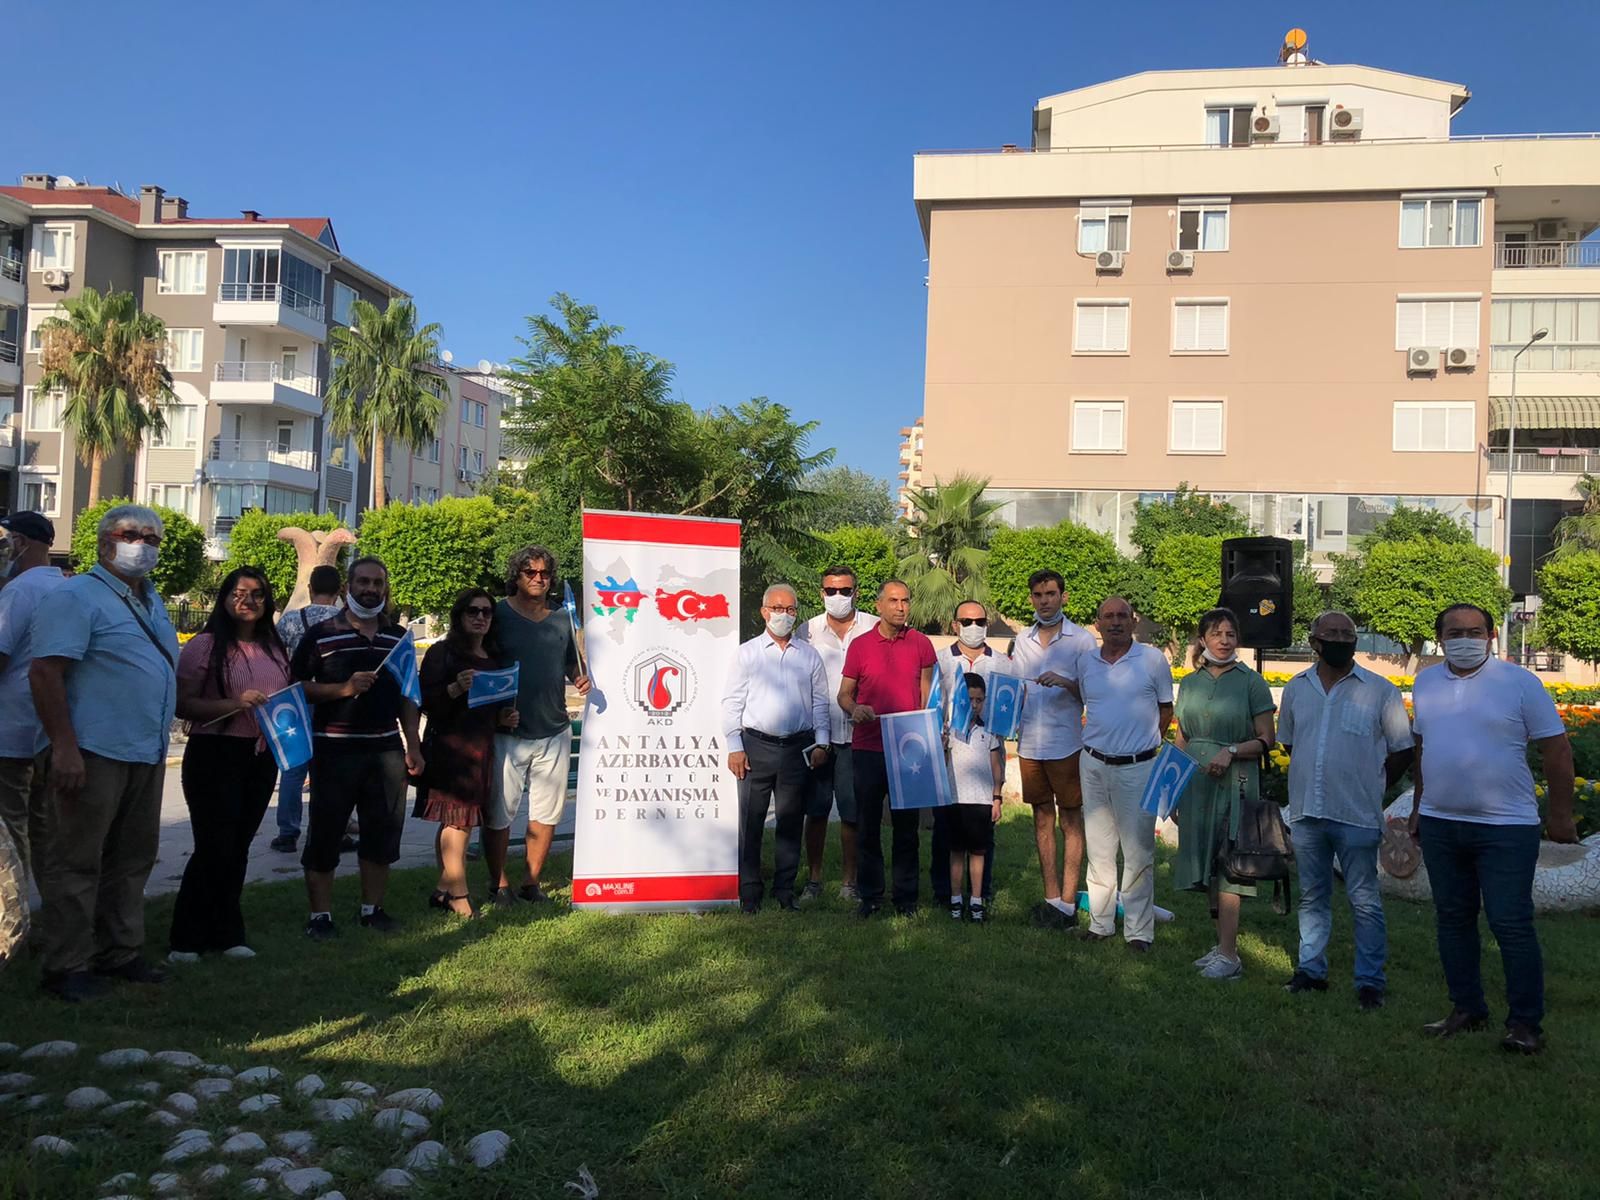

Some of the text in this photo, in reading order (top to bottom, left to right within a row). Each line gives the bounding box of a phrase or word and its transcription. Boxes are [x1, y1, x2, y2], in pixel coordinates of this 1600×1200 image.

[647, 718, 673, 726] AKD
[597, 735, 719, 750] ANTALYA
[596, 754, 720, 768] AZERBAYCAN
[596, 771, 720, 783] KÜLTÜR
[596, 788, 720, 805] VE DAYANIŞMA
[595, 804, 719, 820] DERNEĞİ
[602, 882, 635, 890] MAXLINE
